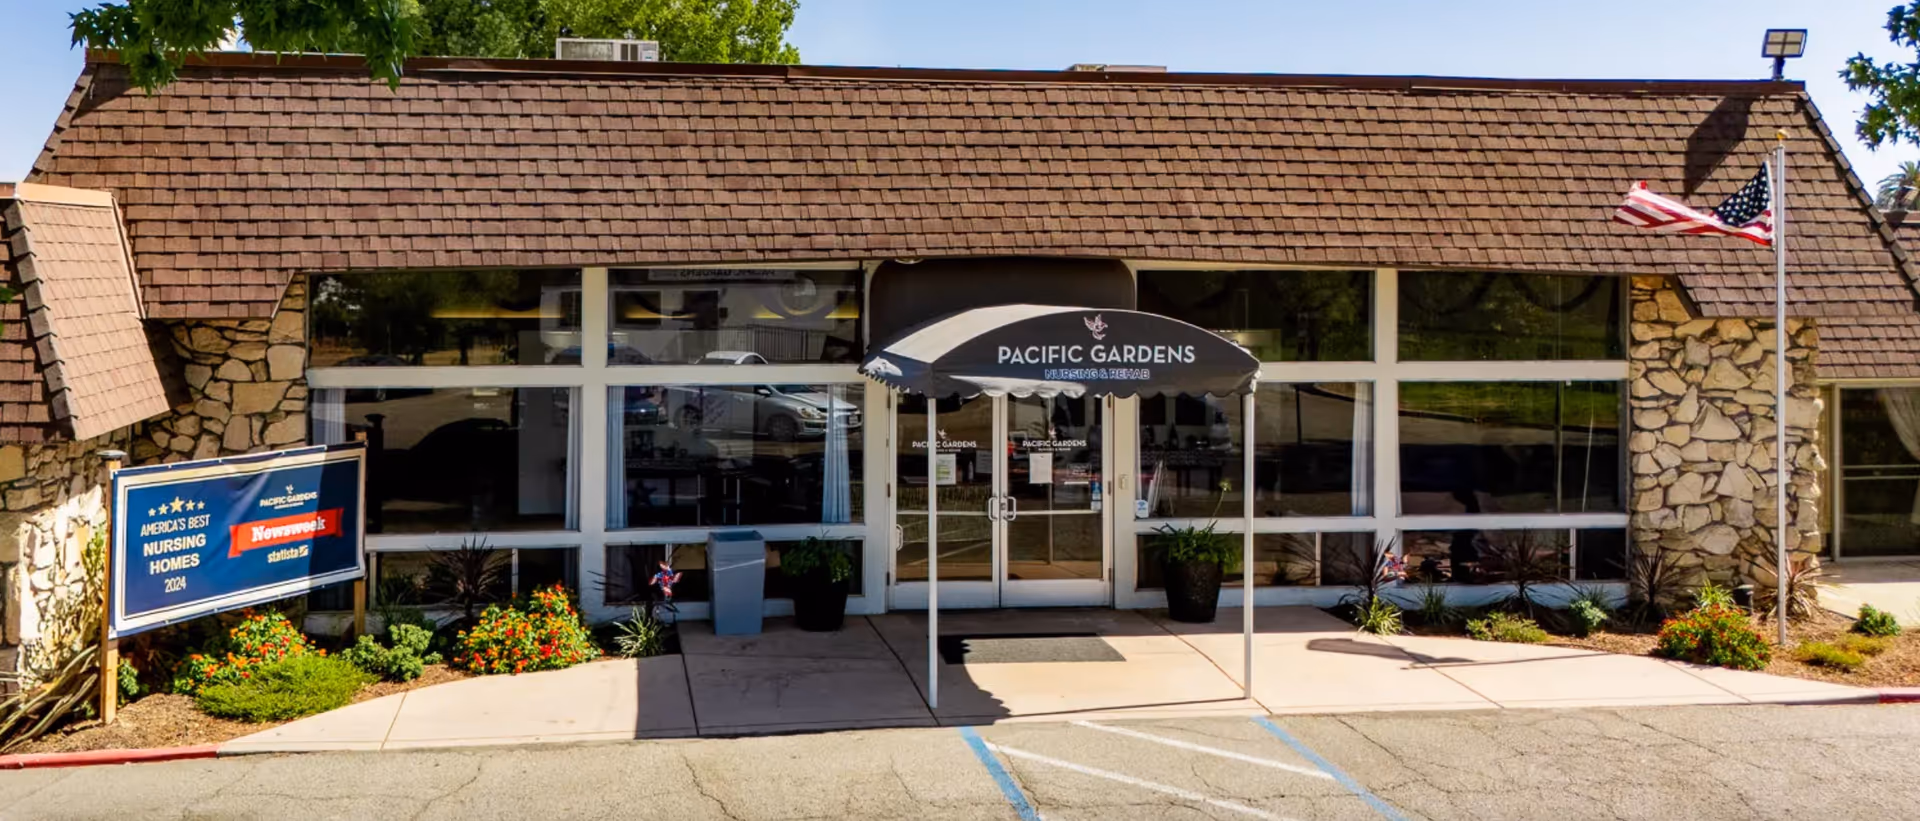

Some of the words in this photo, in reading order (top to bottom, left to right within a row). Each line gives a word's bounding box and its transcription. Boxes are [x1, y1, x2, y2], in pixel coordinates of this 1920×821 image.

[998, 345, 1083, 364] PACIFIC
[1091, 344, 1195, 363] GARDENS
[1045, 369, 1099, 380] NURSING
[1100, 369, 1108, 380] &
[1109, 369, 1150, 380] REHAB
[912, 440, 941, 448] PACIC
[942, 440, 977, 448] GARDENS
[1022, 439, 1051, 447] PACIFIC
[1052, 439, 1087, 447] GARDENS
[259, 496, 286, 507] PACIFIC
[286, 491, 318, 503] GARDENS
[140, 517, 187, 537] AMERICA'S
[188, 514, 210, 529] BEST
[251, 516, 326, 542] Newsweek
[143, 533, 206, 557] NURSING
[267, 546, 299, 563] statista
[150, 553, 200, 575] HOMES
[164, 576, 186, 593] 2024
